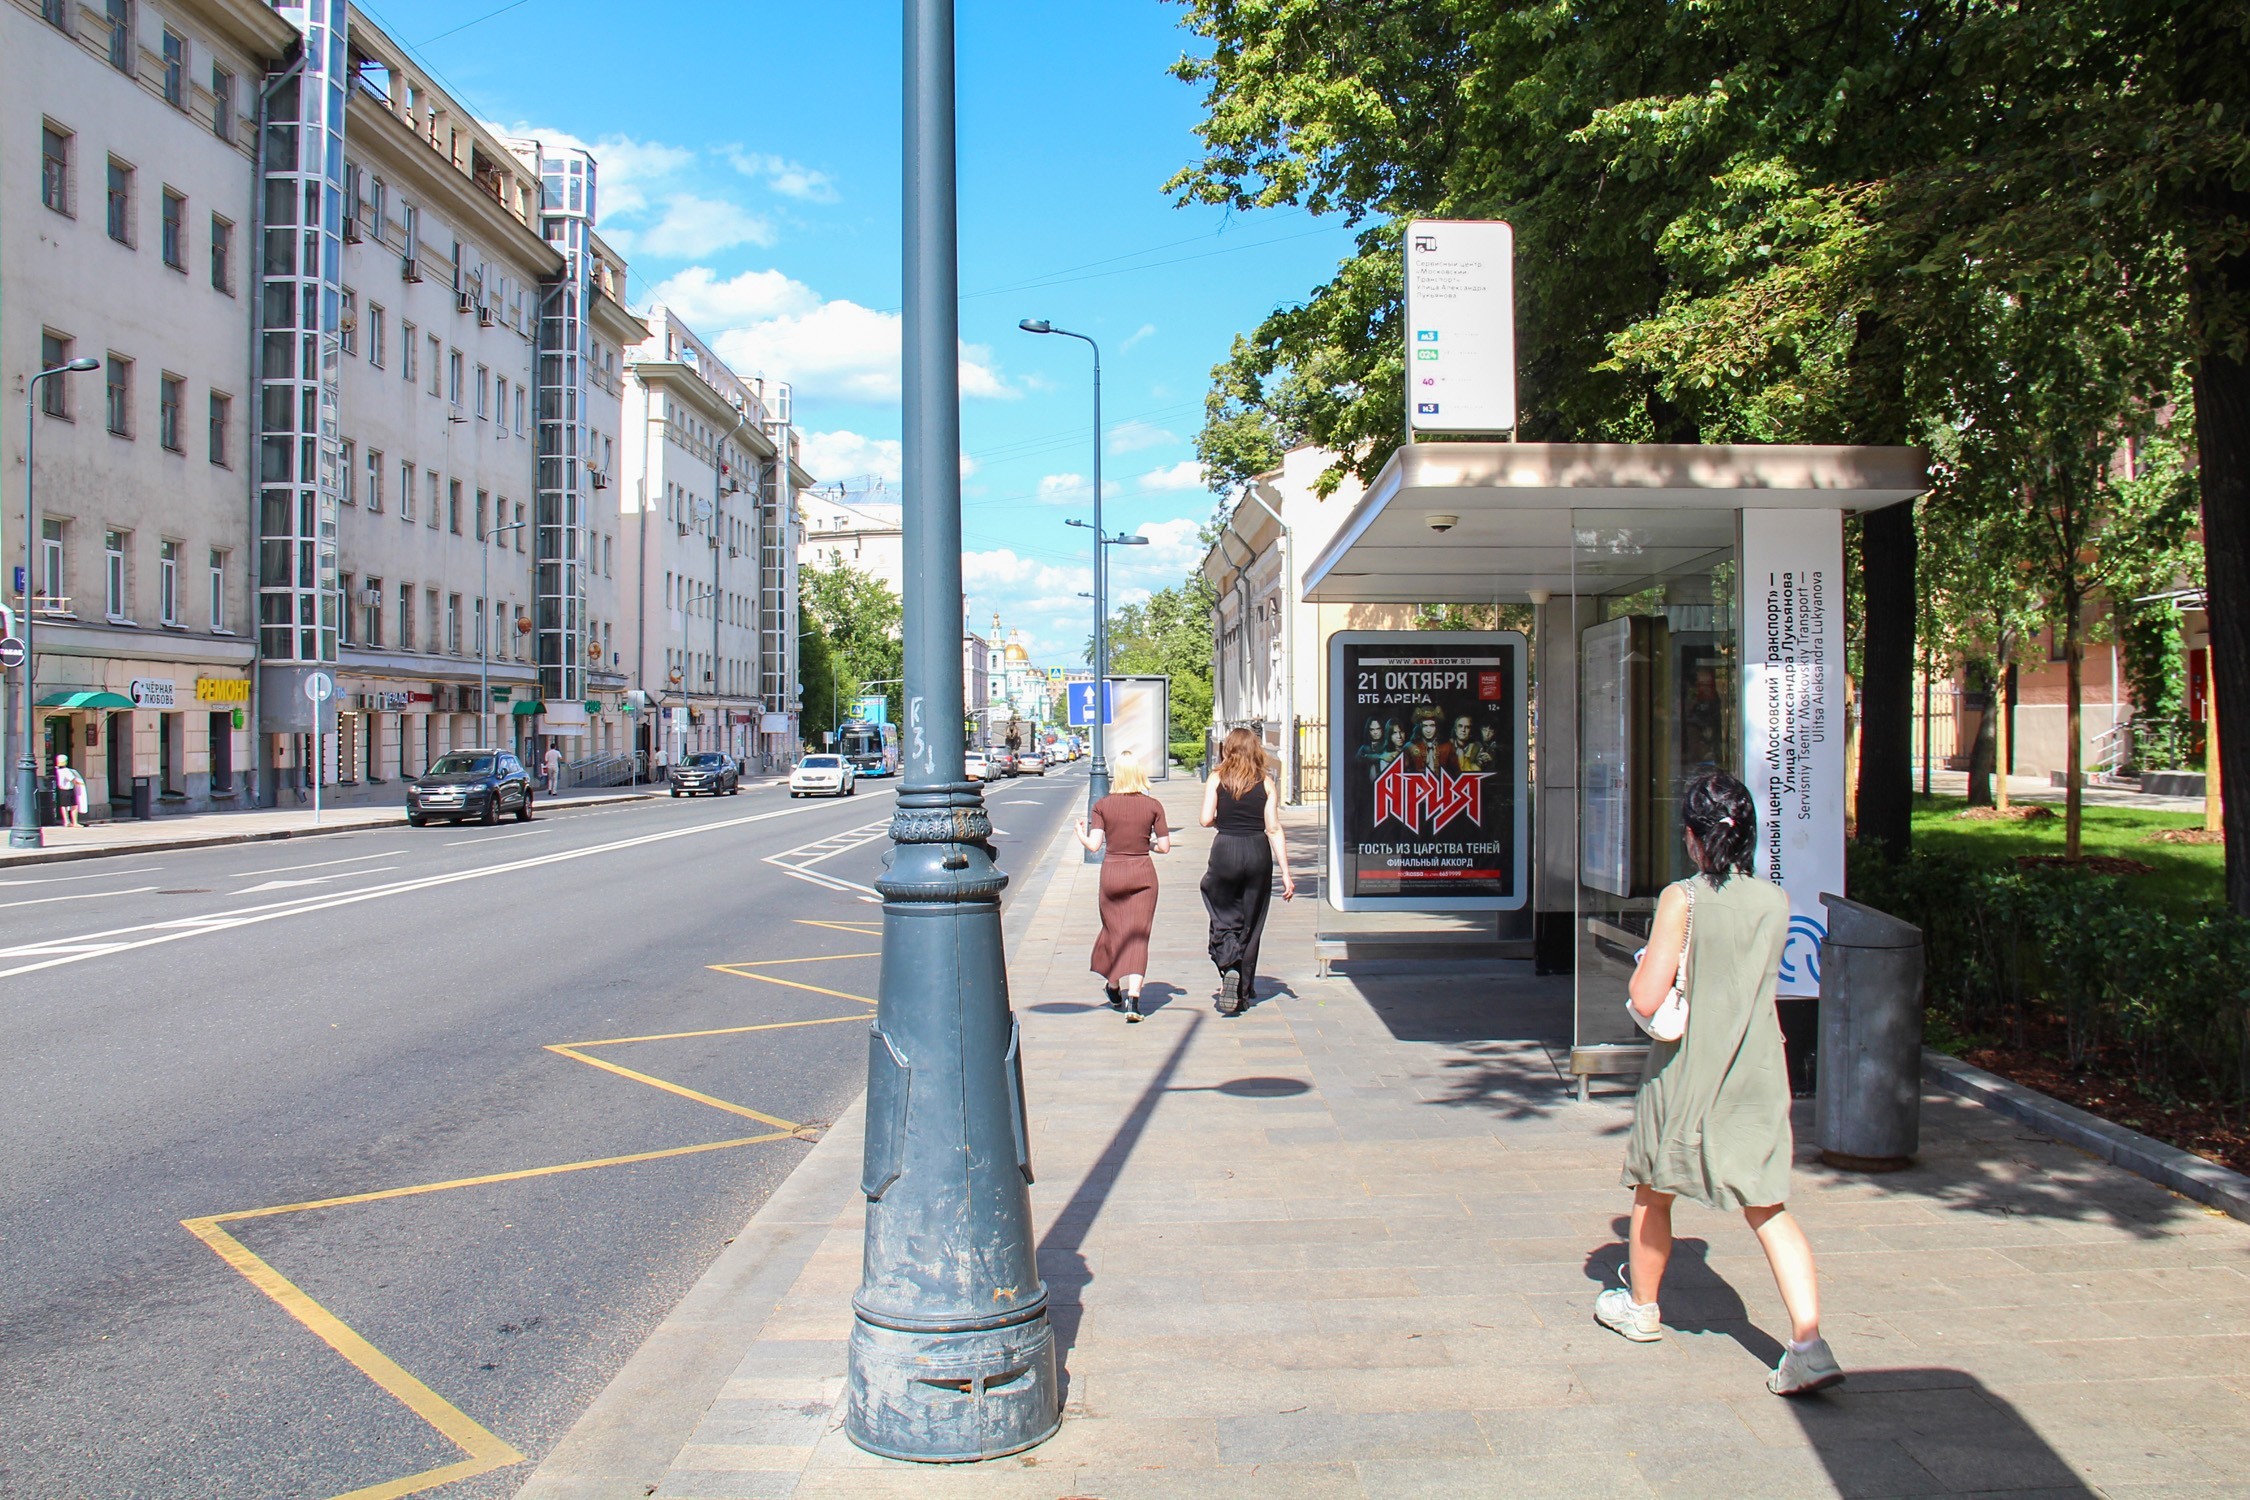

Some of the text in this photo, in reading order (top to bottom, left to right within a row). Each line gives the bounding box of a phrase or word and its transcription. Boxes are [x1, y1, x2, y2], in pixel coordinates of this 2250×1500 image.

[1422, 378, 1435, 386] 40
[1765, 590, 1782, 671] Транспорт»
[1796, 587, 1812, 646] Transport
[1810, 571, 1825, 743] Ulitsa Aleksandra Lukyanova
[144, 693, 174, 705] ЛЮБОВЬ
[145, 681, 173, 694] ЧЁРНАЯ
[196, 678, 251, 702] РЕМОНТ
[1358, 672, 1377, 690] 21
[1385, 672, 1468, 690] ОКТЯБРЯ
[1358, 693, 1432, 704] ВТБ АРЕНА
[1782, 572, 1797, 794] Улица Александра Лукьянова
[1797, 648, 1812, 720] Moskovskiy
[1765, 677, 1781, 770] «Московский
[1798, 724, 1810, 762] Tsentr
[1374, 751, 1498, 835] АРИЯ
[1769, 776, 1783, 816] центр
[1798, 764, 1813, 820] Servisniy
[1358, 840, 1500, 856] ГОСТЬ ИЗ ЦАРСТВА ТЕНЕЙ
[1386, 856, 1473, 868] ФИНАЛЬНЫЙ АККОРД
